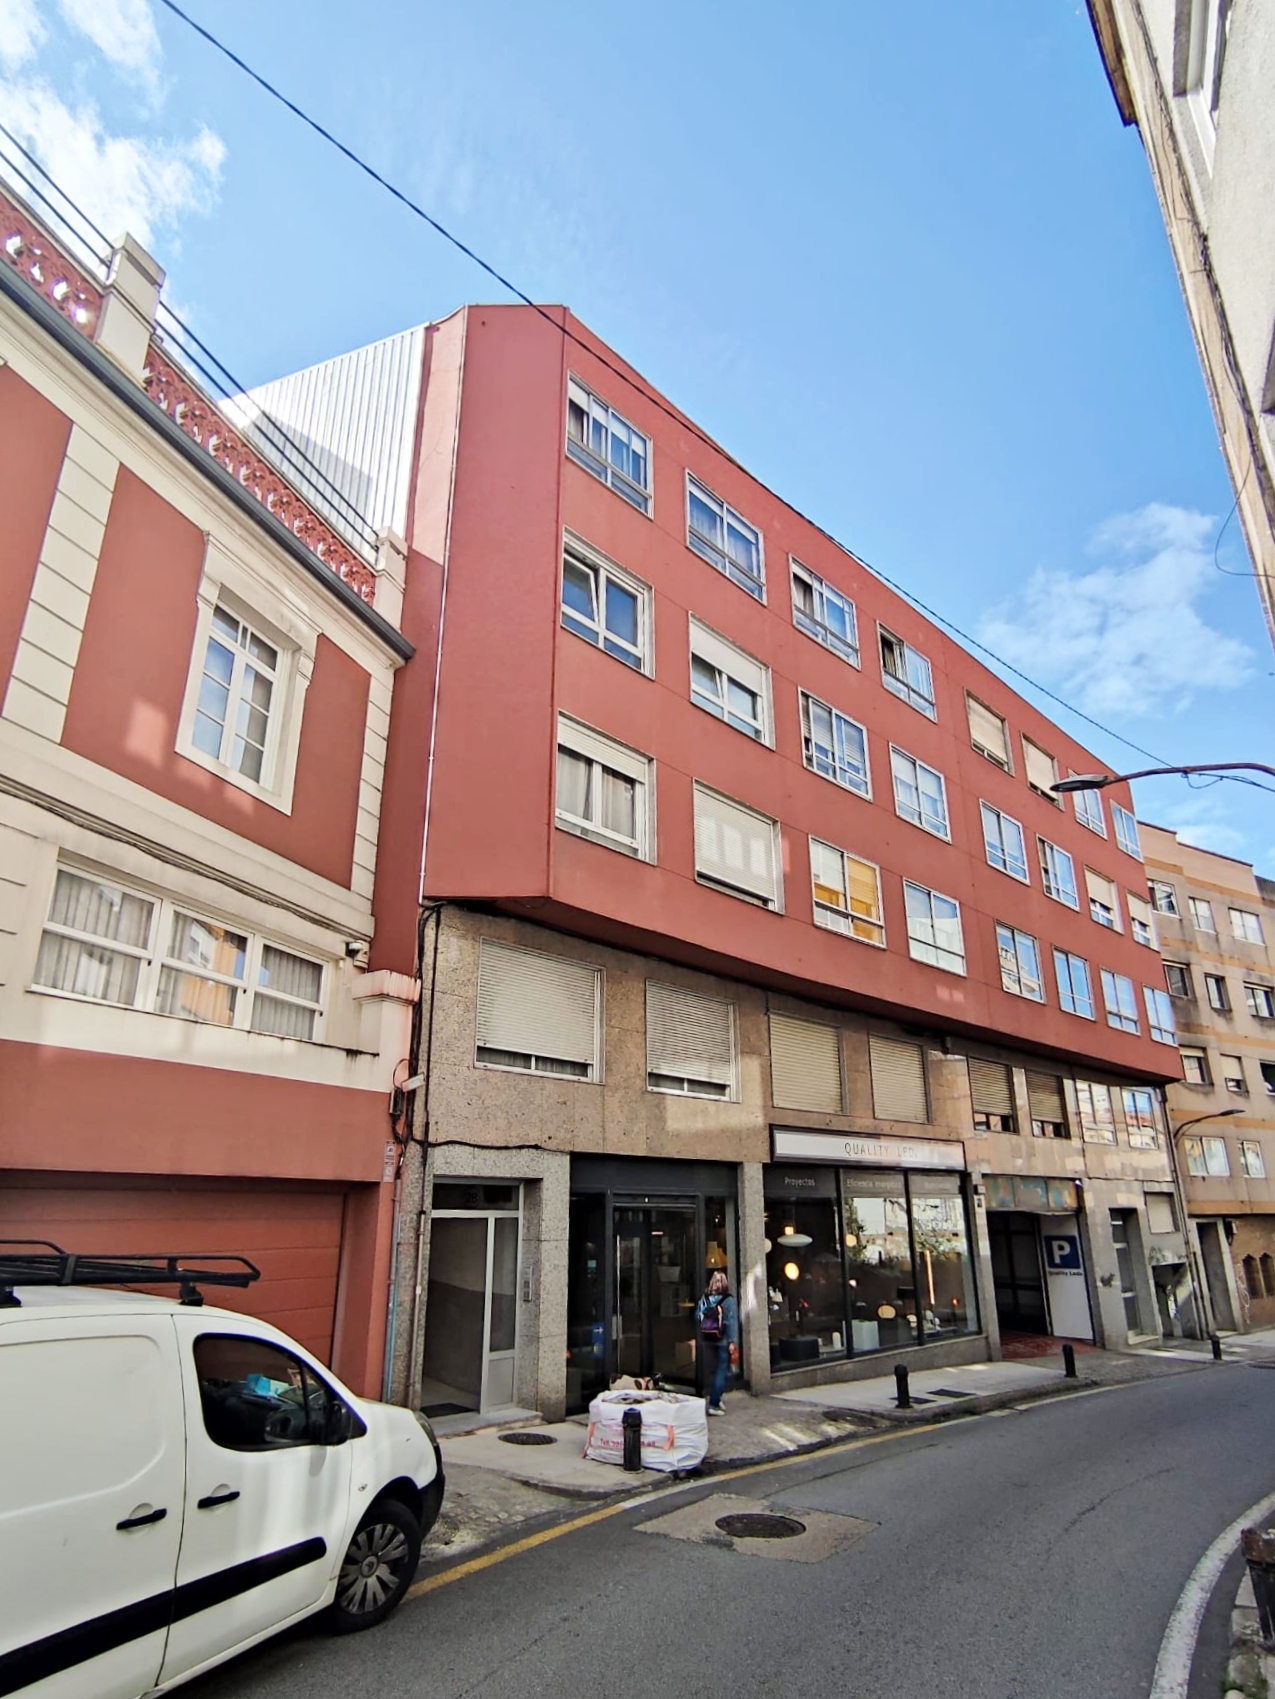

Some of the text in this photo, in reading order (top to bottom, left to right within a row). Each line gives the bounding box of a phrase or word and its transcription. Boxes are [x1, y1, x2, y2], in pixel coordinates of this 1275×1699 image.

[844, 1142, 889, 1157] QUALITY
[784, 1175, 816, 1188] Proyectos
[1051, 1240, 1070, 1264] P
